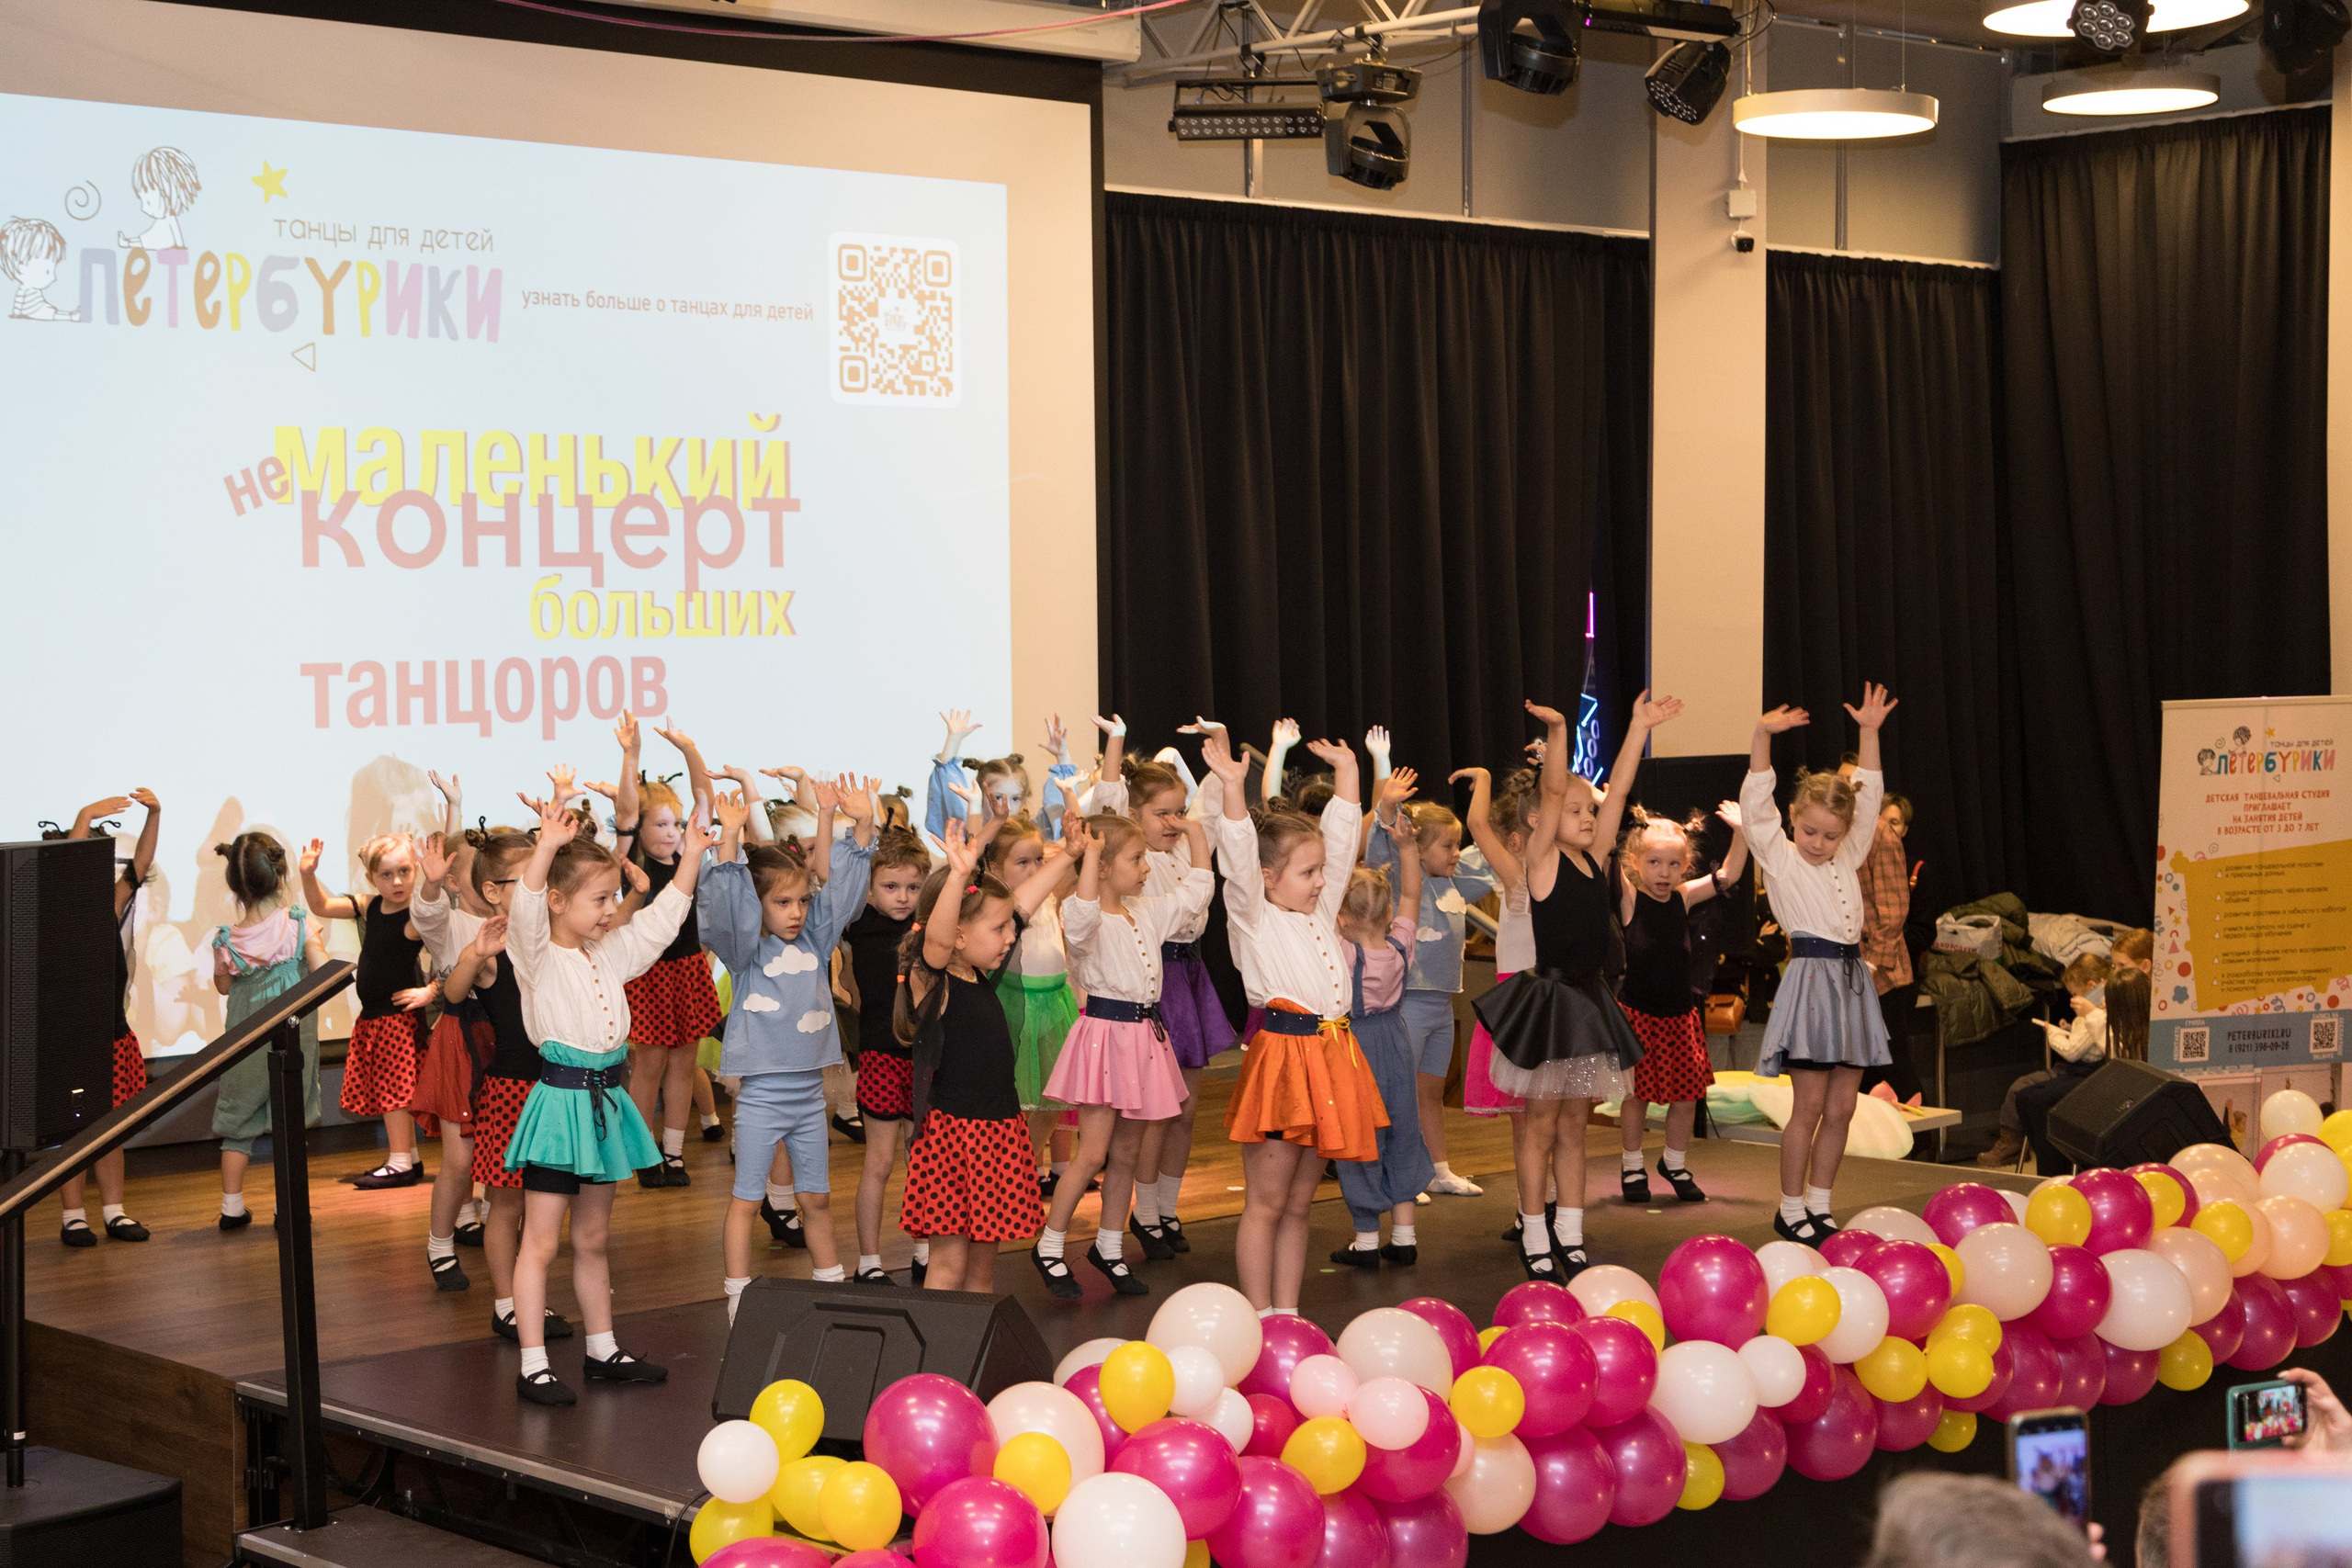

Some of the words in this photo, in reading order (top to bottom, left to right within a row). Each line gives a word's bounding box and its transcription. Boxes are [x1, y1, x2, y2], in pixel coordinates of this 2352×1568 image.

[274, 219, 357, 244] танцы
[368, 226, 410, 249] для
[420, 228, 494, 254] детей
[521, 288, 581, 310] узнать
[585, 289, 652, 313] больше
[656, 299, 666, 313] о
[671, 297, 729, 320] танцах
[733, 300, 763, 321] для
[766, 302, 814, 322] детей
[223, 455, 290, 516] не
[274, 412, 791, 509] маленький
[300, 489, 801, 602] концерт
[529, 573, 797, 640] больших
[300, 654, 670, 741] танцоров
[2205, 793, 2239, 804] ДЕТСКАЯ
[2245, 791, 2298, 801] ТАНЦЕВАЛЬНАЯ
[2301, 790, 2330, 799] СТУДИЯ
[2244, 802, 2291, 812] ПРИГЛАШАЕТ
[2217, 827, 2222, 835] В
[2224, 825, 2261, 835] ВОЗРАСТЕ
[2264, 825, 2274, 833] ОТ
[2283, 824, 2294, 833] ДО
[2305, 823, 2319, 831] ЛЕТ
[2233, 815, 2242, 823] НА
[2244, 814, 2277, 823] ЗАНЯТИЯ
[2278, 812, 2302, 822] ДЕТЕЙ
[2227, 1029, 2291, 1042] PETERBURIKI.RU
[2228, 1044, 2233, 1054] 8
[2235, 1043, 2253, 1054] (921)
[2255, 1041, 2290, 1052] 396-09-26
